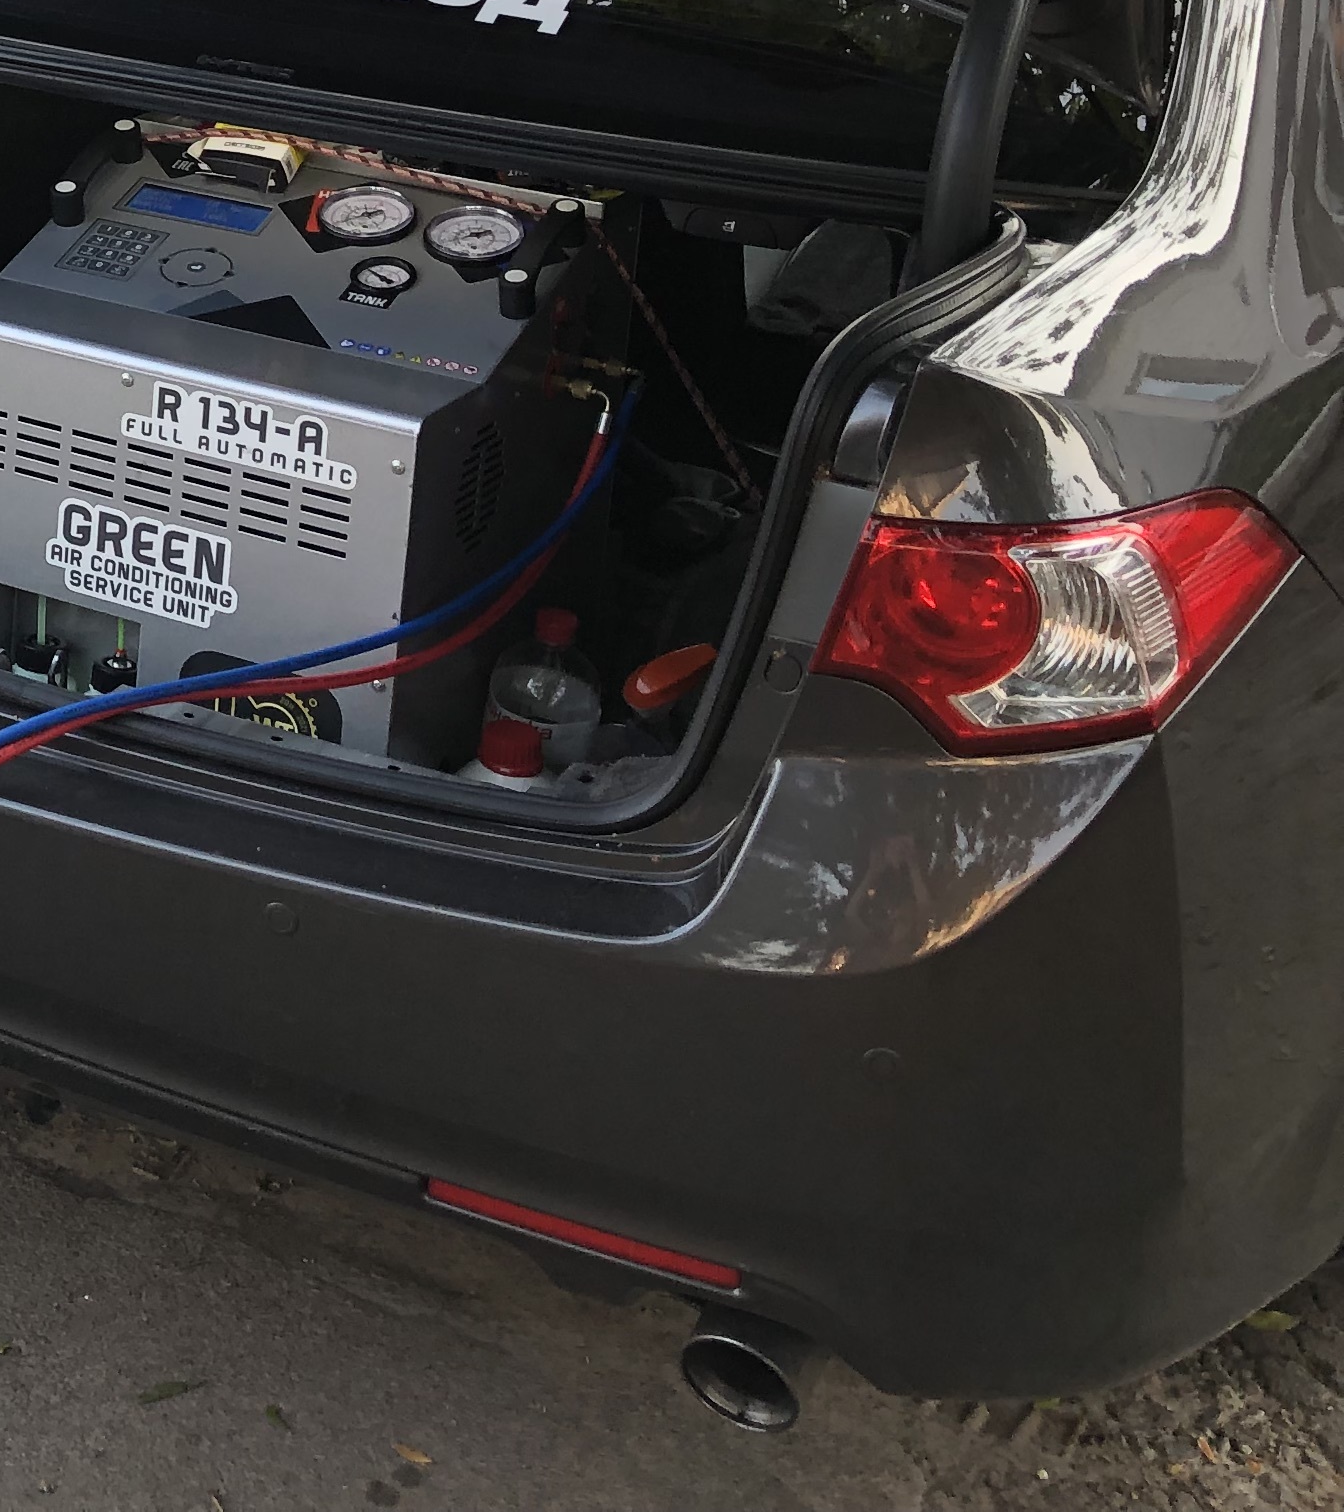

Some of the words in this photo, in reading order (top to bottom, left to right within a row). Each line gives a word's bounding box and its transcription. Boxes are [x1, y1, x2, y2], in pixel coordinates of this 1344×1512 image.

[346, 290, 389, 308] TANK
[126, 417, 182, 445] FULL
[198, 435, 353, 485] AUTOMATIC
[157, 386, 182, 422] R
[198, 396, 324, 456] 134-A
[50, 544, 83, 567] AIR
[90, 554, 232, 608] CONDITIONING
[62, 503, 226, 585] GREEN
[69, 569, 154, 608] SERVICE
[162, 595, 210, 623] UNIT
